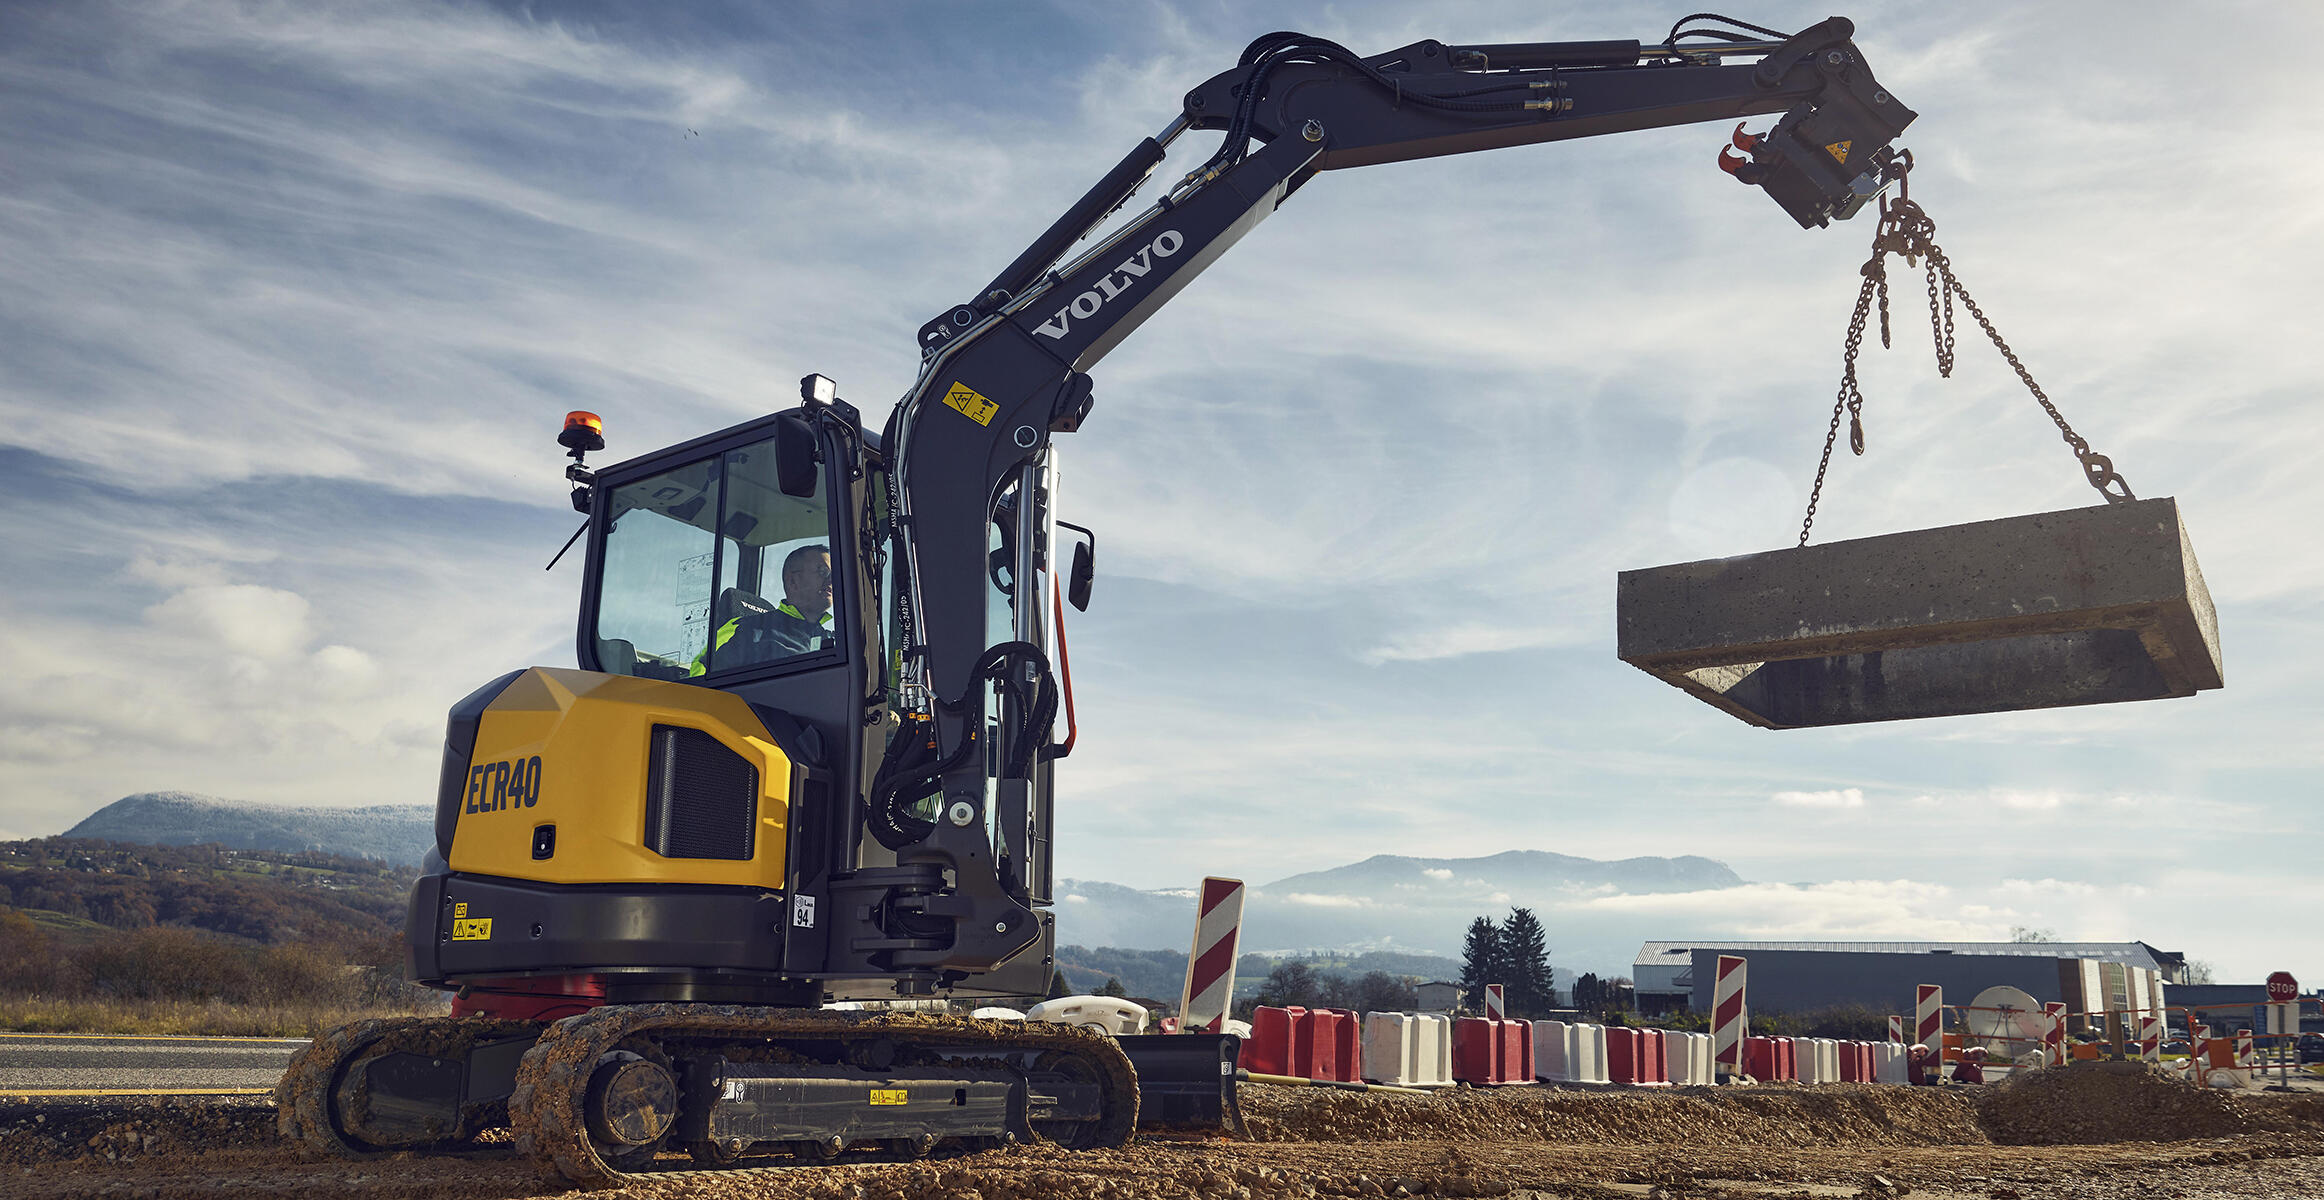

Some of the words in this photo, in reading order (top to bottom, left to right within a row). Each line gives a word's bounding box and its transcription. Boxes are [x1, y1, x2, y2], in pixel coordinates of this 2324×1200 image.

[1031, 230, 1184, 340] VOLVO
[466, 755, 542, 815] ECR40
[797, 908, 809, 926] 94
[2270, 982, 2296, 994] STOP
